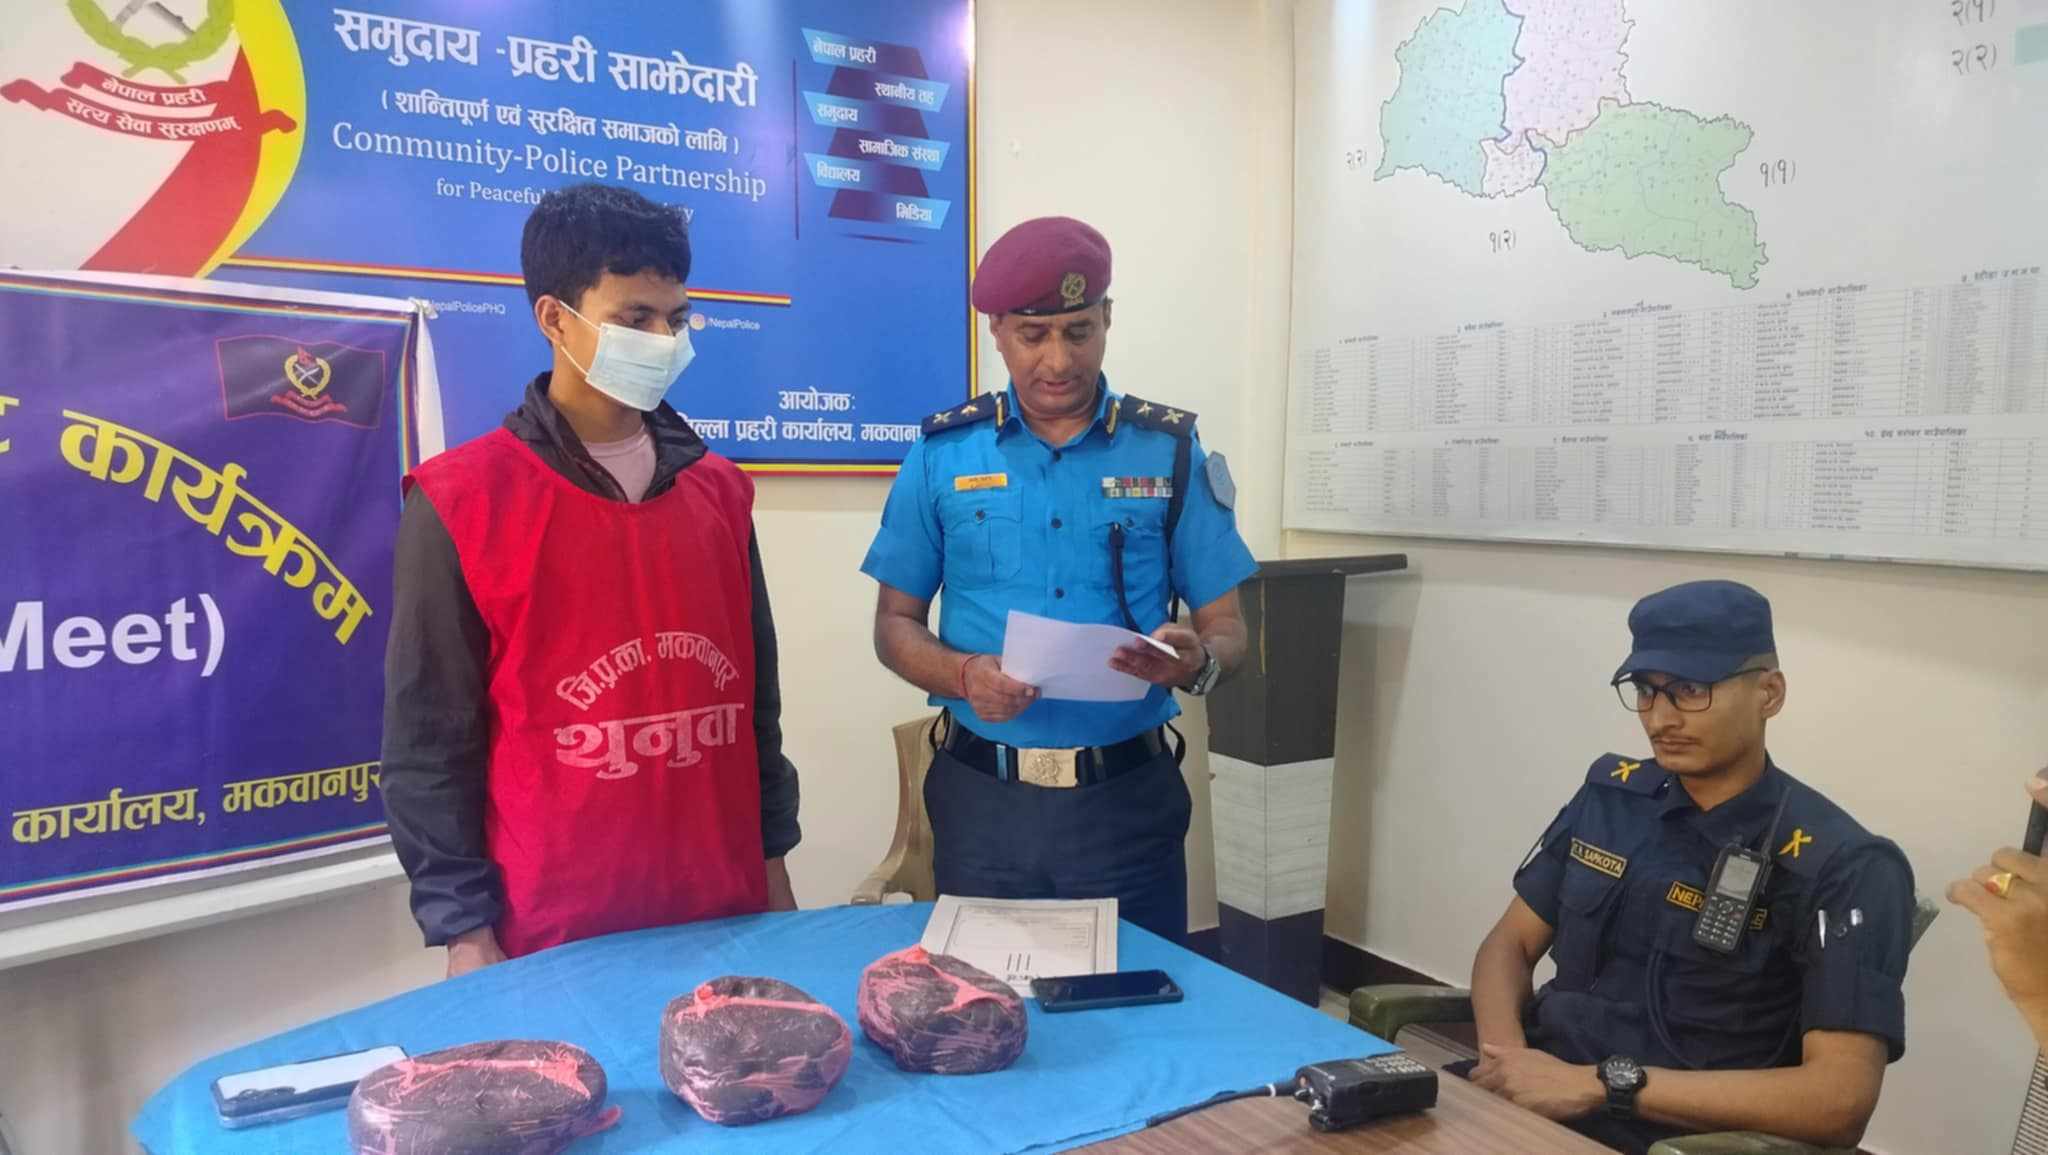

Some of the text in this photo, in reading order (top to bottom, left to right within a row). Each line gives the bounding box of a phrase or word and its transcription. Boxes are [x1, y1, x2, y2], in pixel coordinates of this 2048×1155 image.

[333, 8, 480, 67] समुदाय
[608, 50, 758, 107] साझेदारी
[813, 37, 876, 64] नेपाल प्रहरी
[102, 76, 207, 106] नेपाल प्रहरी
[874, 80, 916, 101] स्थानीय
[66, 97, 110, 124] सत्य
[116, 111, 151, 135] सेवा
[816, 104, 859, 123] समुदाय
[496, 101, 522, 128] एवं
[527, 106, 597, 137] सुरक्षित
[601, 120, 680, 147] समाजको
[685, 129, 729, 154] लागि
[332, 121, 768, 202] Community-Police Partnership
[858, 138, 909, 159] सामाजिक
[816, 161, 861, 183] विद्यालय
[436, 178, 465, 200] for
[895, 202, 933, 222] मिडिया
[734, 415, 777, 442] प्रहरी
[655, 631, 740, 691] मकवानपुर
[552, 703, 745, 780] थुनुवा
